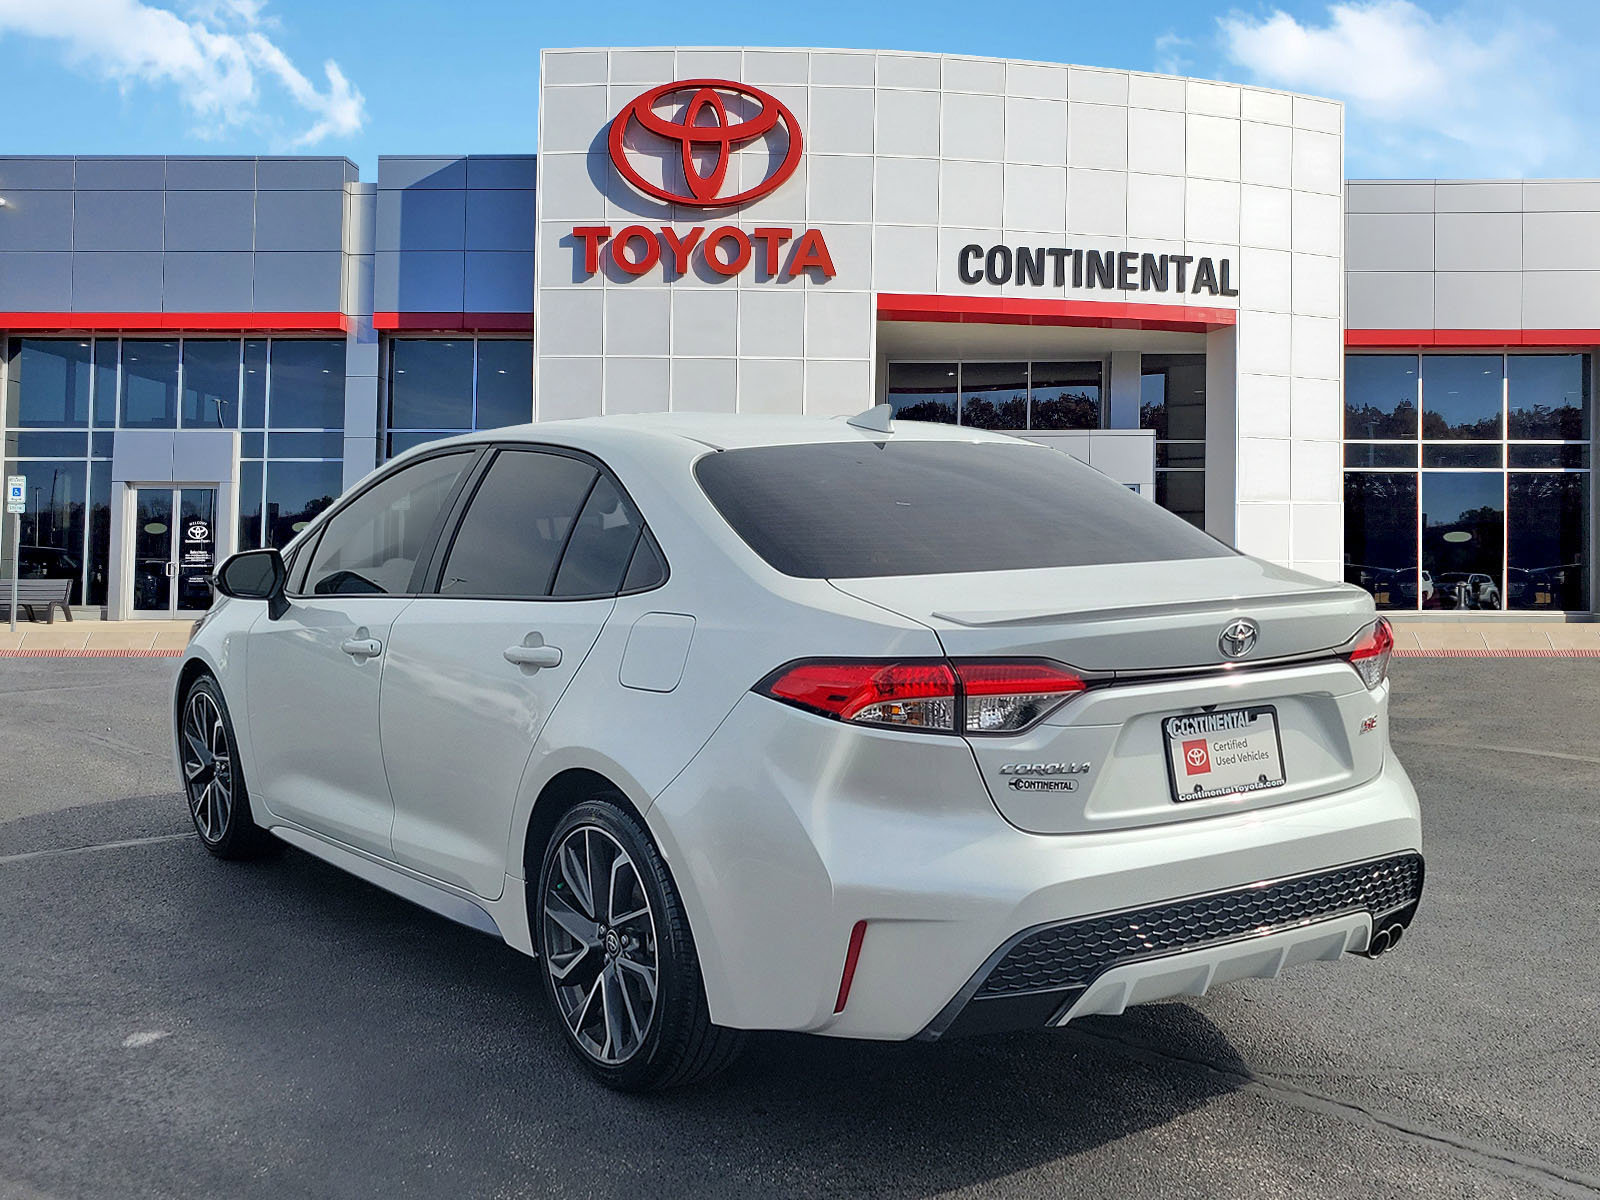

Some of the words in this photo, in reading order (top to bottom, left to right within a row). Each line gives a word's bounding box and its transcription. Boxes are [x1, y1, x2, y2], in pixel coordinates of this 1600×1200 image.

[572, 225, 837, 278] TOYOTA
[959, 243, 1240, 297] CONTINENTAL
[1167, 711, 1250, 738] CONTINENTAL
[1213, 738, 1248, 752] Certified
[1215, 755, 1236, 766] Used
[1237, 750, 1270, 763] Vehicles
[999, 762, 1091, 776] COROLLA
[1015, 778, 1073, 790] CONTINENTAL
[1178, 779, 1285, 801] ContinentalToyota.com
